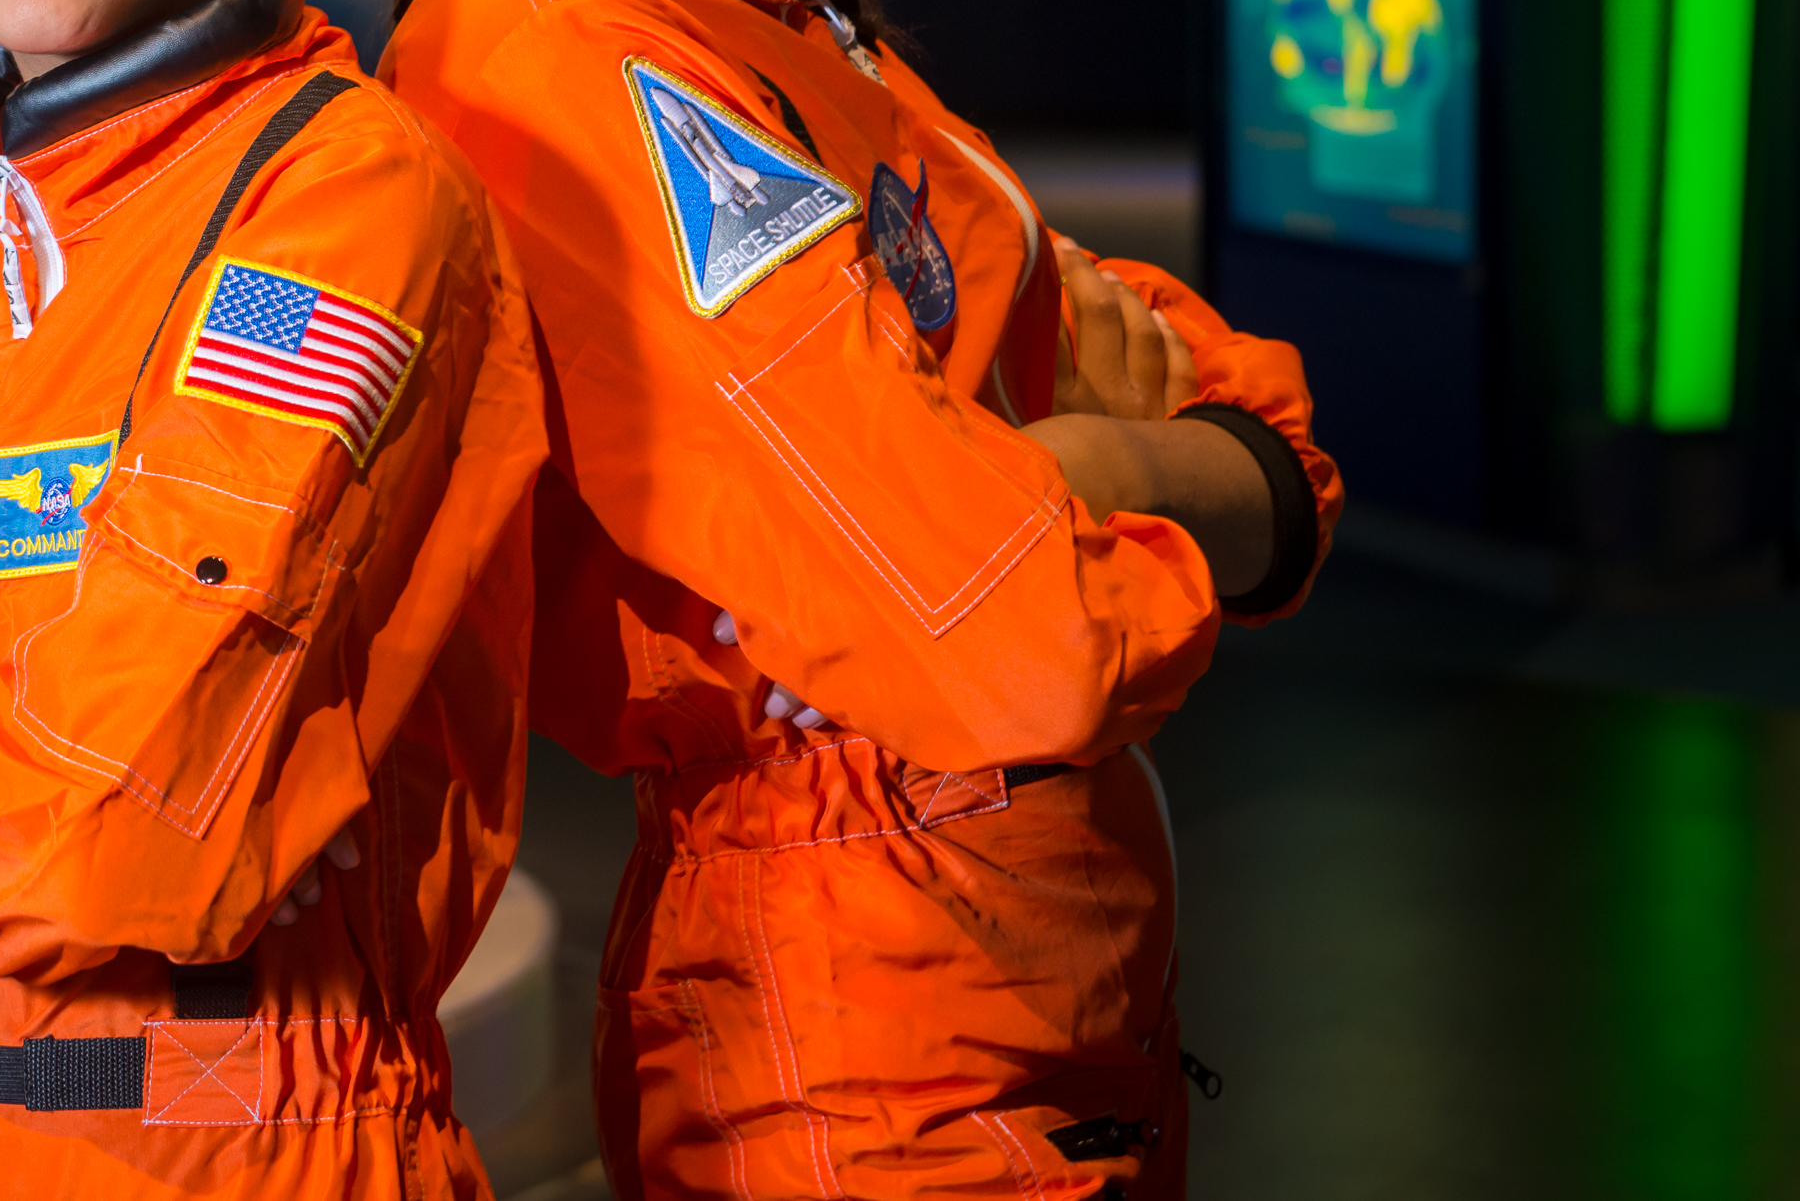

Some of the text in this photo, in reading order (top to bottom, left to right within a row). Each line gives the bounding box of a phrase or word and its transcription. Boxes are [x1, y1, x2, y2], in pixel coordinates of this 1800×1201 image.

[708, 186, 838, 284] SPACE SHUTTLE
[41, 494, 71, 512] NASA
